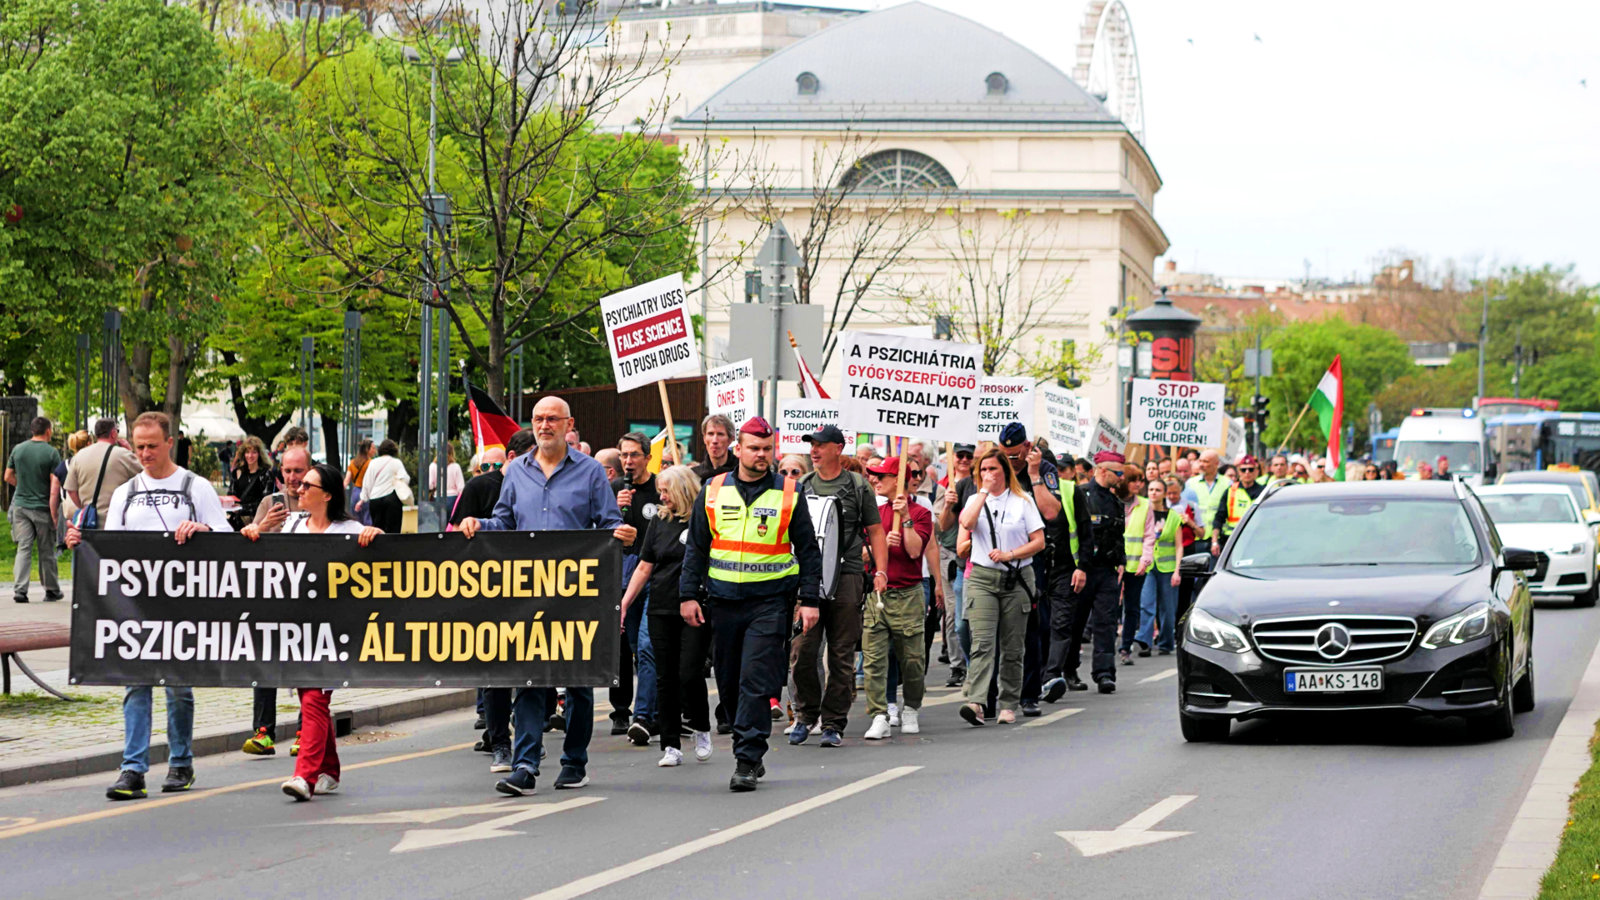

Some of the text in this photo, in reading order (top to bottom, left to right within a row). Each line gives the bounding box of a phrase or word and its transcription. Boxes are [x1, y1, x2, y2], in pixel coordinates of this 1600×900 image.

[606, 289, 683, 327] PSYCHIATRY USES
[616, 316, 683, 352] FALSE SCIENCE
[619, 342, 690, 378] TO PUSH DRUGS
[850, 344, 976, 371] A PSZICHIÁTRIA
[850, 383, 971, 410] TÁRSADALMAT
[1158, 383, 1199, 398] STOP
[979, 396, 1014, 406] ZELÉS:
[1140, 396, 1216, 411] PSYCHIATRIC
[783, 408, 840, 419] PSZICHIÁTR
[877, 408, 939, 429] TEREMT
[978, 411, 1019, 420] SEJTEK
[1148, 408, 1206, 421] DRUGGING
[1155, 420, 1198, 433] OF OUR
[1143, 431, 1207, 445] CHILDREN!
[744, 562, 780, 572] POLICE
[98, 558, 599, 599] PSYCHIATRY: PSEUDOSCIENCE
[95, 611, 599, 661] PSZICHIÁTRIA: ÁLTUDOMÁNY
[1299, 674, 1317, 689] AA
[1325, 673, 1379, 689] KS-148
